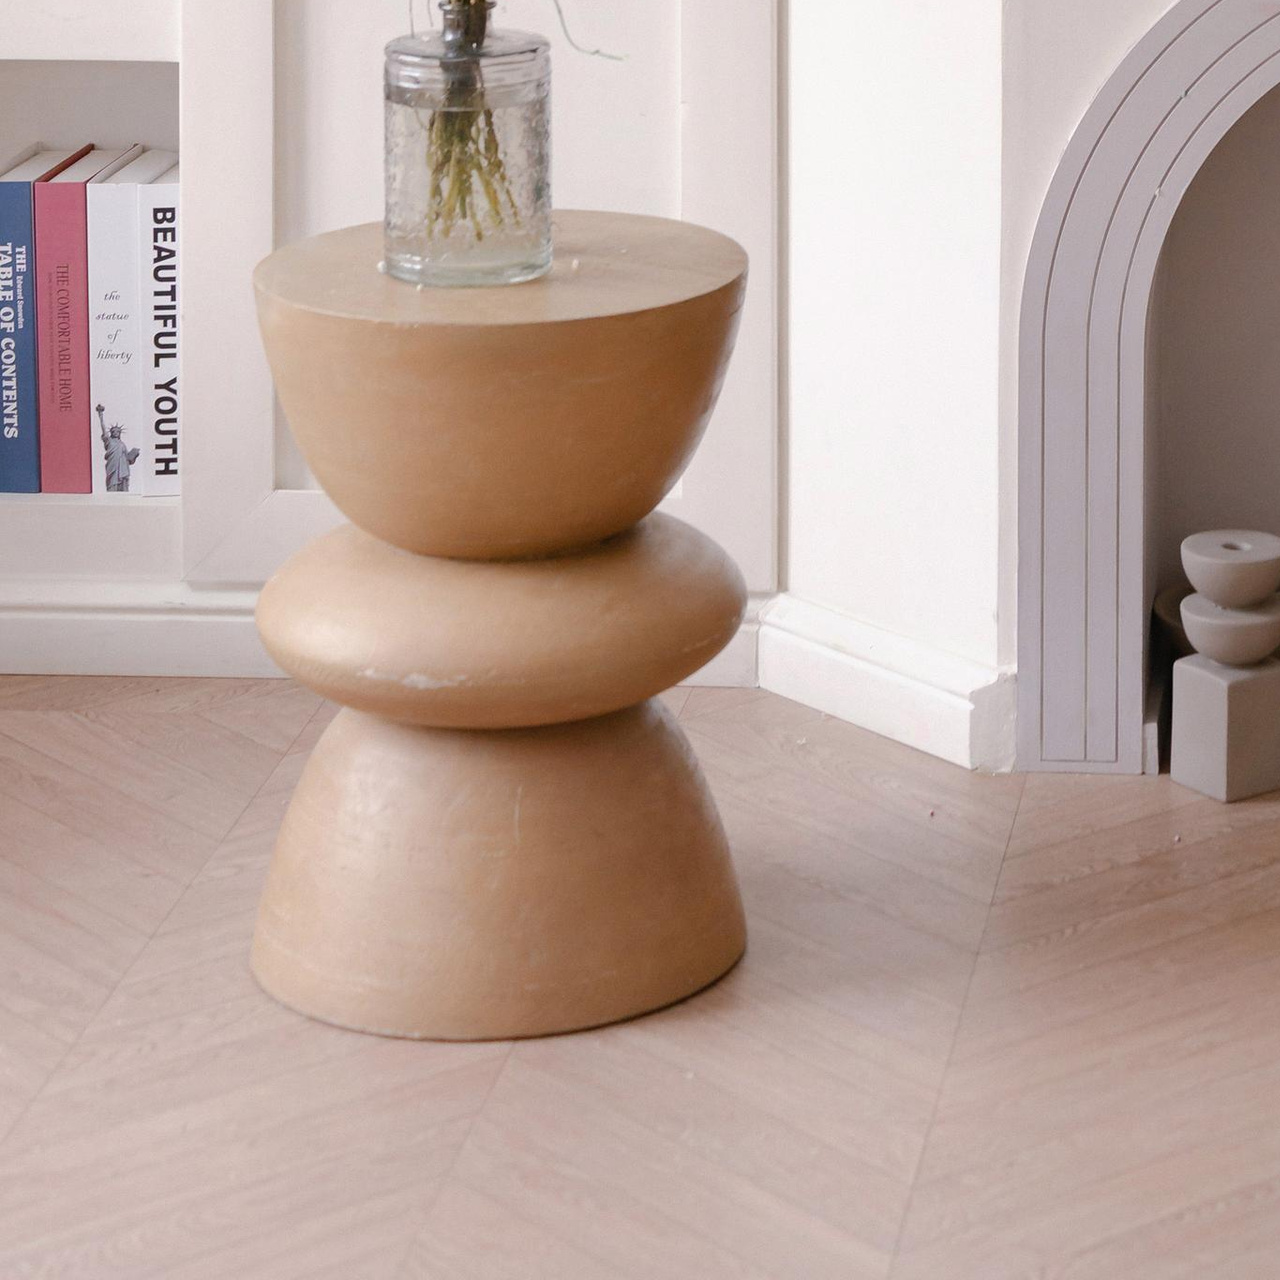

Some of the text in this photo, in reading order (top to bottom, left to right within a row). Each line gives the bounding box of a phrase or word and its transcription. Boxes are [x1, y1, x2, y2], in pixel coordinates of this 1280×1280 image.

[16, 245, 27, 272] THE
[104, 290, 120, 301] the
[96, 313, 129, 321] statue
[0, 243, 18, 438] TABLE OF CONTENTS
[57, 264, 72, 413] THE COMFORTABLE HOME
[107, 329, 121, 344] of
[153, 207, 178, 476] BEAUTIFUL YOUTH
[96, 349, 132, 364] liberty
